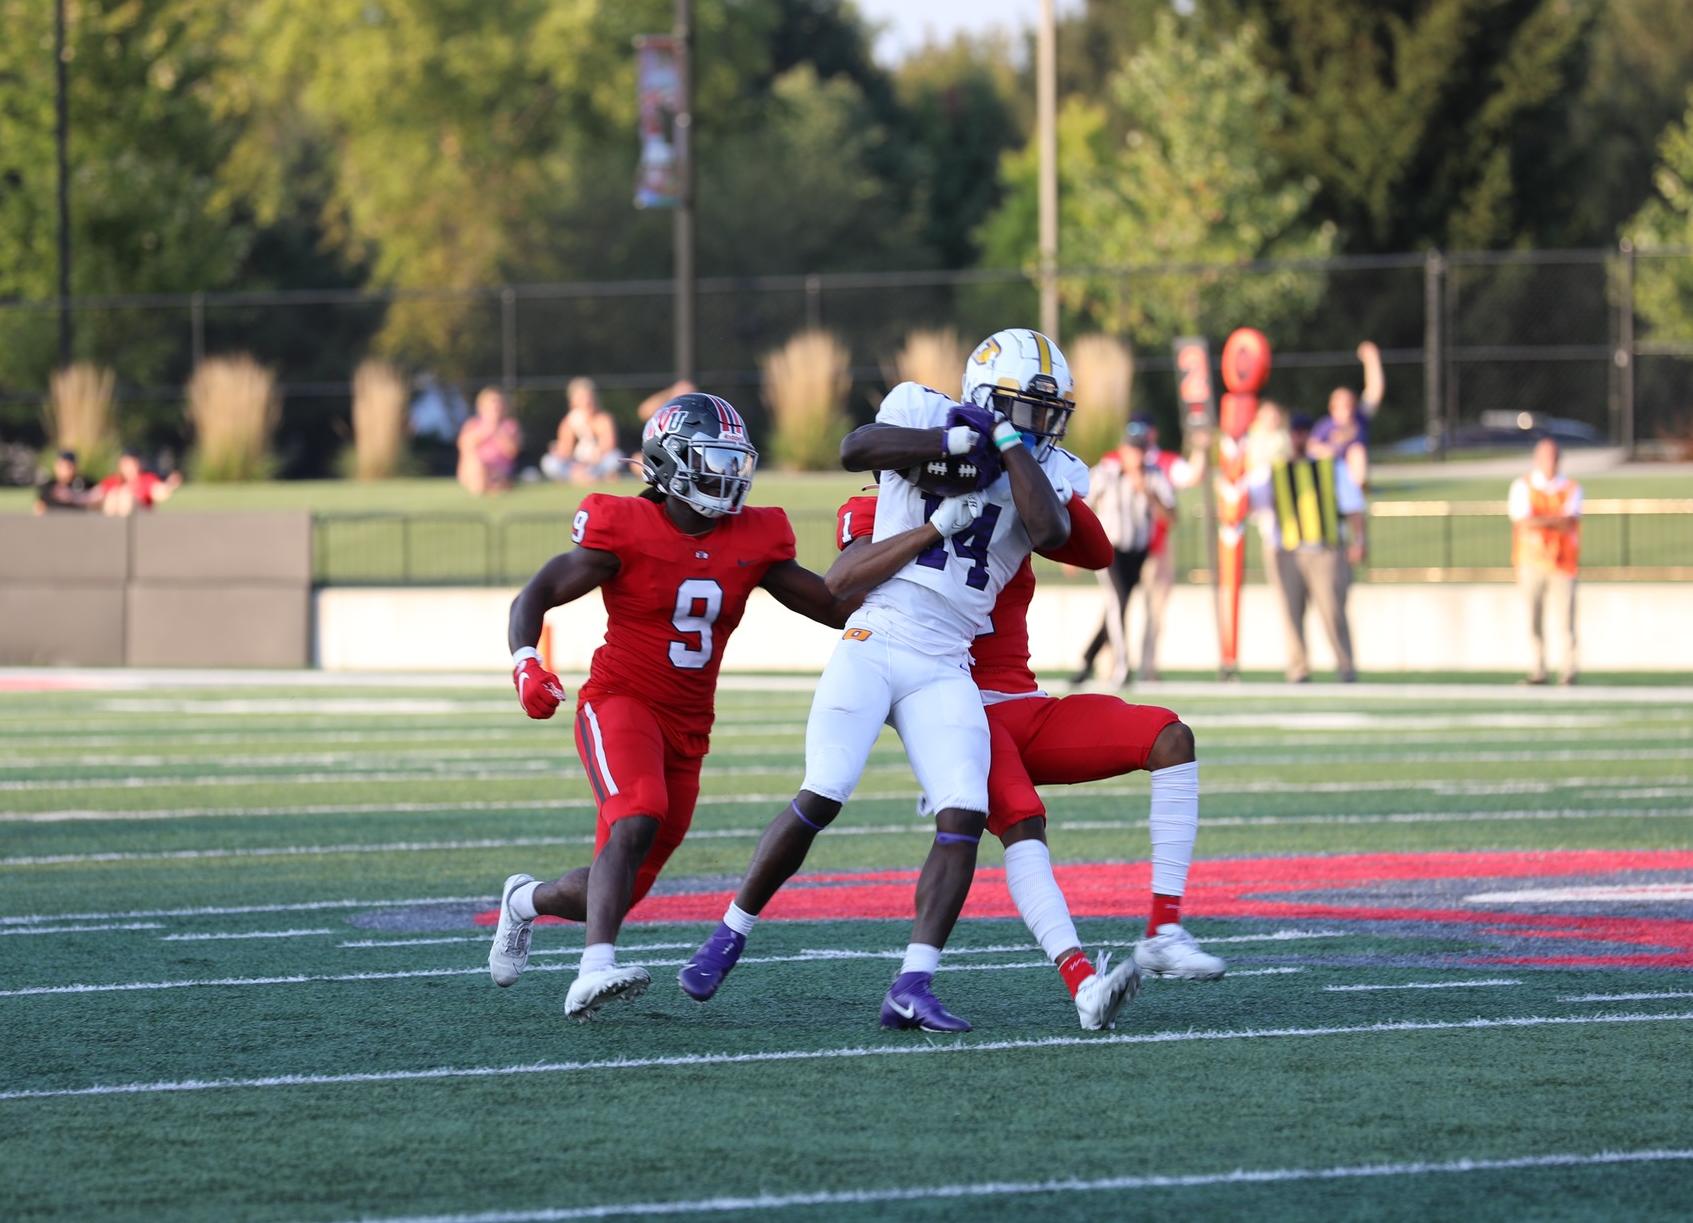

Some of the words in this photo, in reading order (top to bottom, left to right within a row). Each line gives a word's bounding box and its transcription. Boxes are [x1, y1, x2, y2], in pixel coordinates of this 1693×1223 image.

[571, 509, 590, 544] 9
[841, 511, 853, 544] 1
[668, 577, 724, 669] 9
